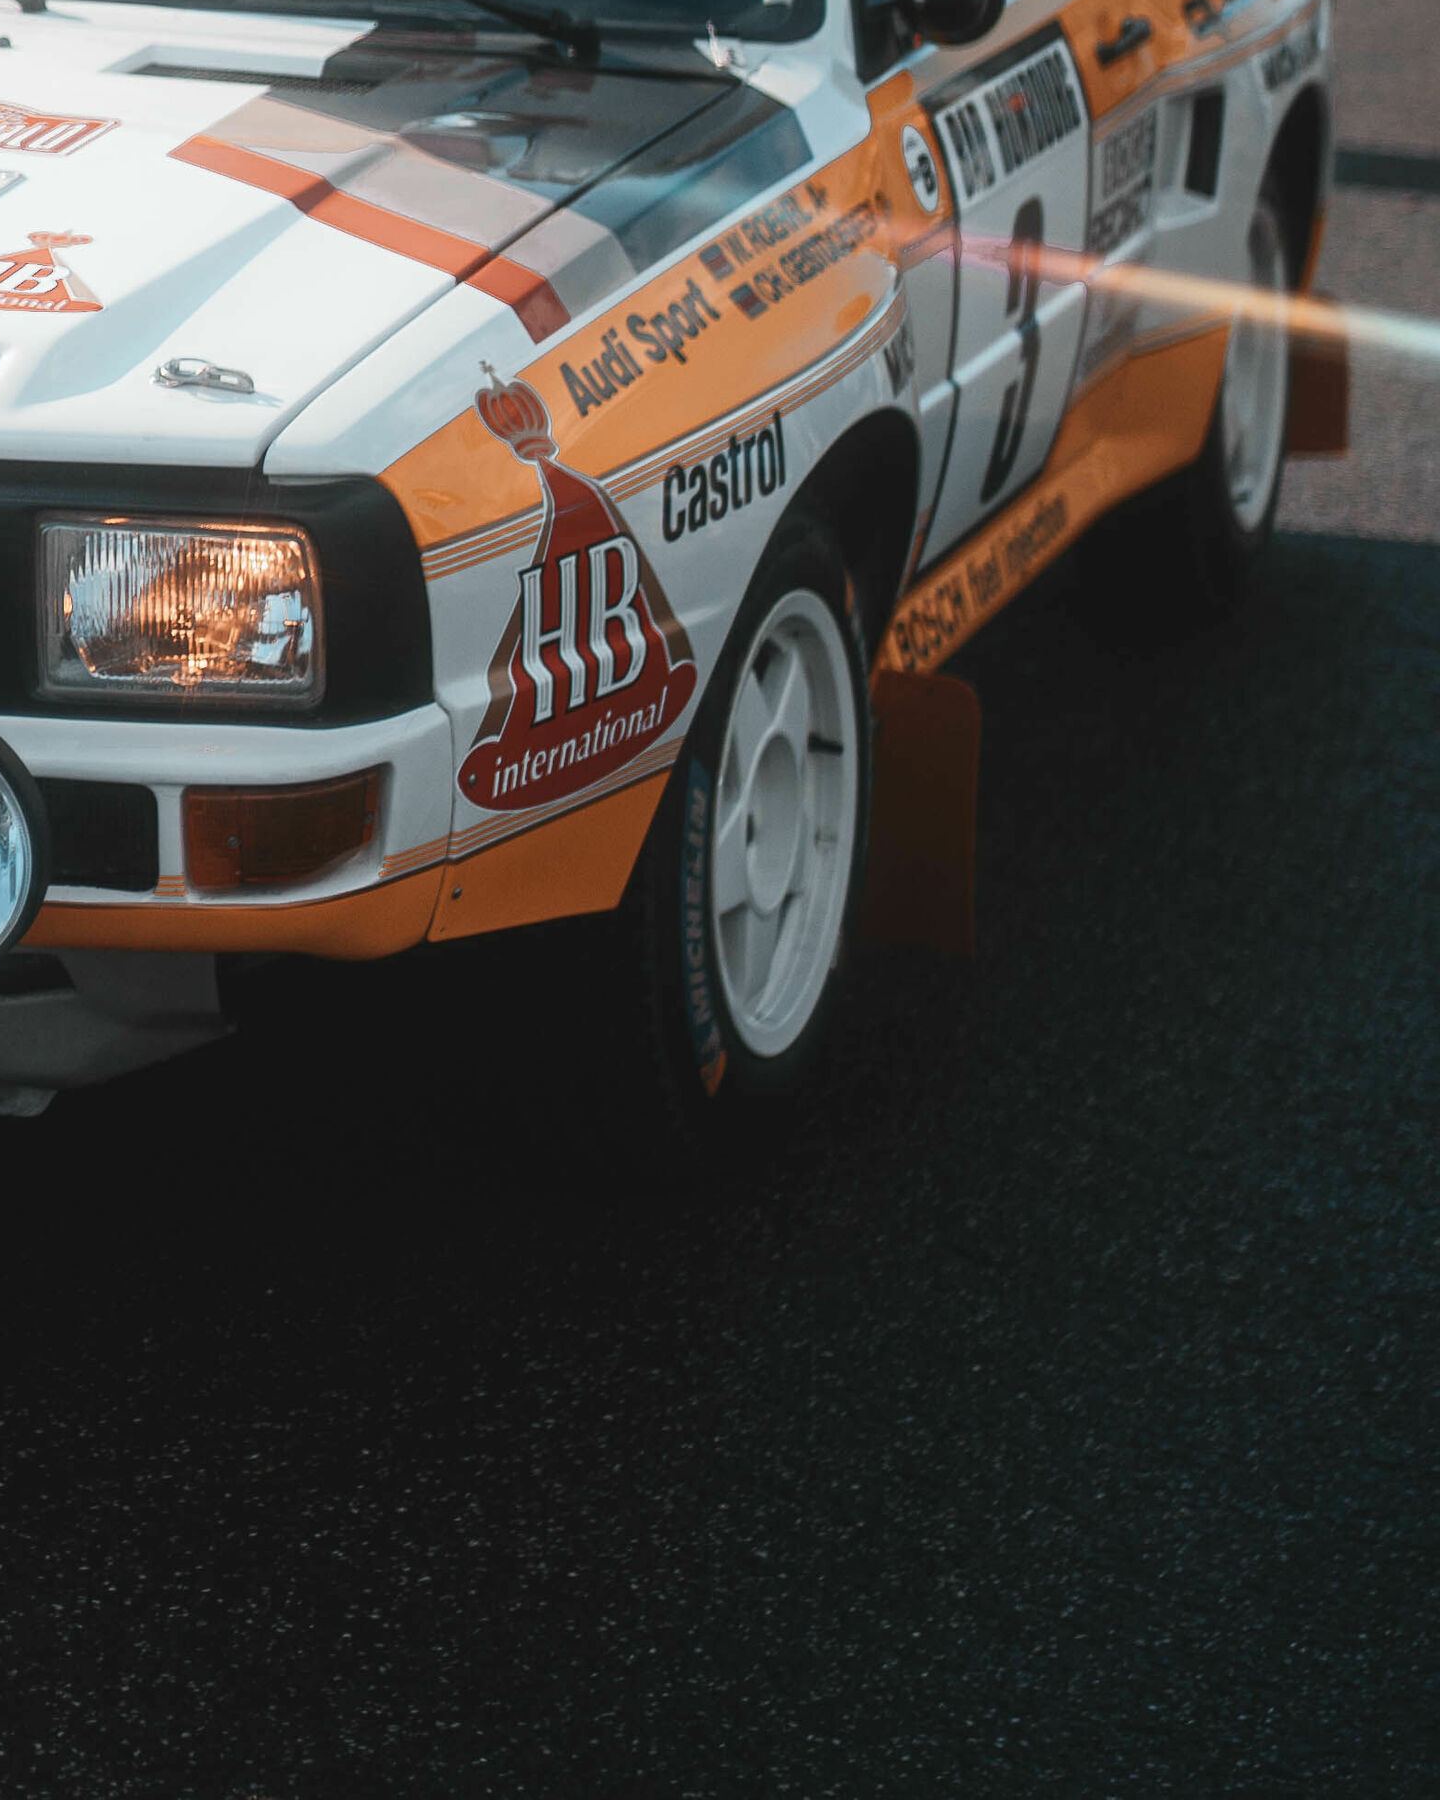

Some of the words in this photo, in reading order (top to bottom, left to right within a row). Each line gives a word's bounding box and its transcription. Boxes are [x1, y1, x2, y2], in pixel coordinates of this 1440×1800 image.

[559, 327, 644, 418] Audi
[627, 277, 721, 364] Sport
[662, 409, 786, 543] Castrol
[516, 531, 649, 729] HB
[491, 686, 668, 799] international
[685, 786, 709, 1025] MICHELIN
